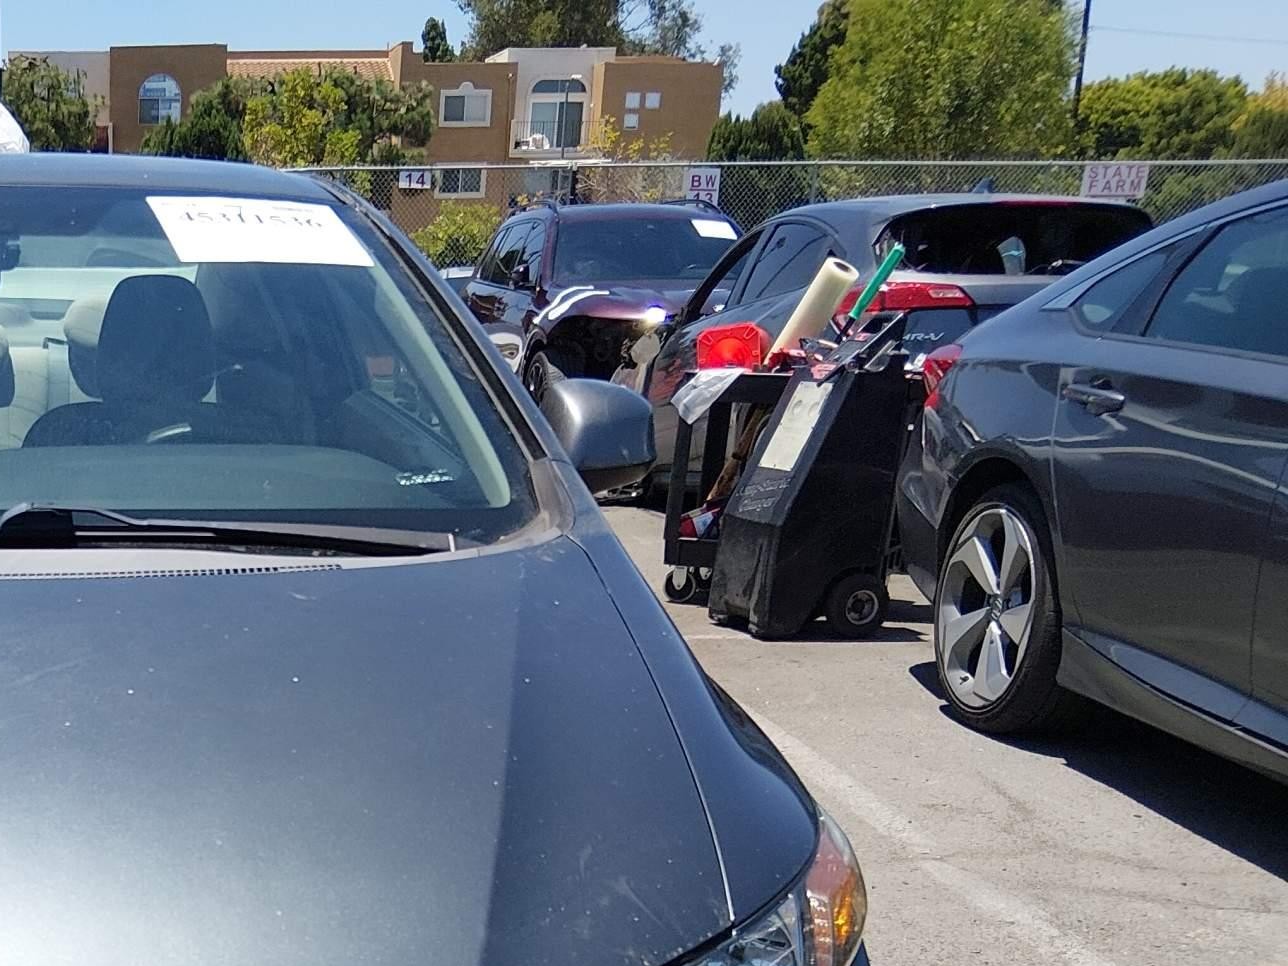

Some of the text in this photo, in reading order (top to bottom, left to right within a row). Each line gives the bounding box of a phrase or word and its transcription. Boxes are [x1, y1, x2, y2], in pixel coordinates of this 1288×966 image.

[1088, 165, 1146, 179] STATE
[405, 172, 426, 188] 14
[691, 174, 717, 188] BW
[1087, 178, 1144, 193] FARM
